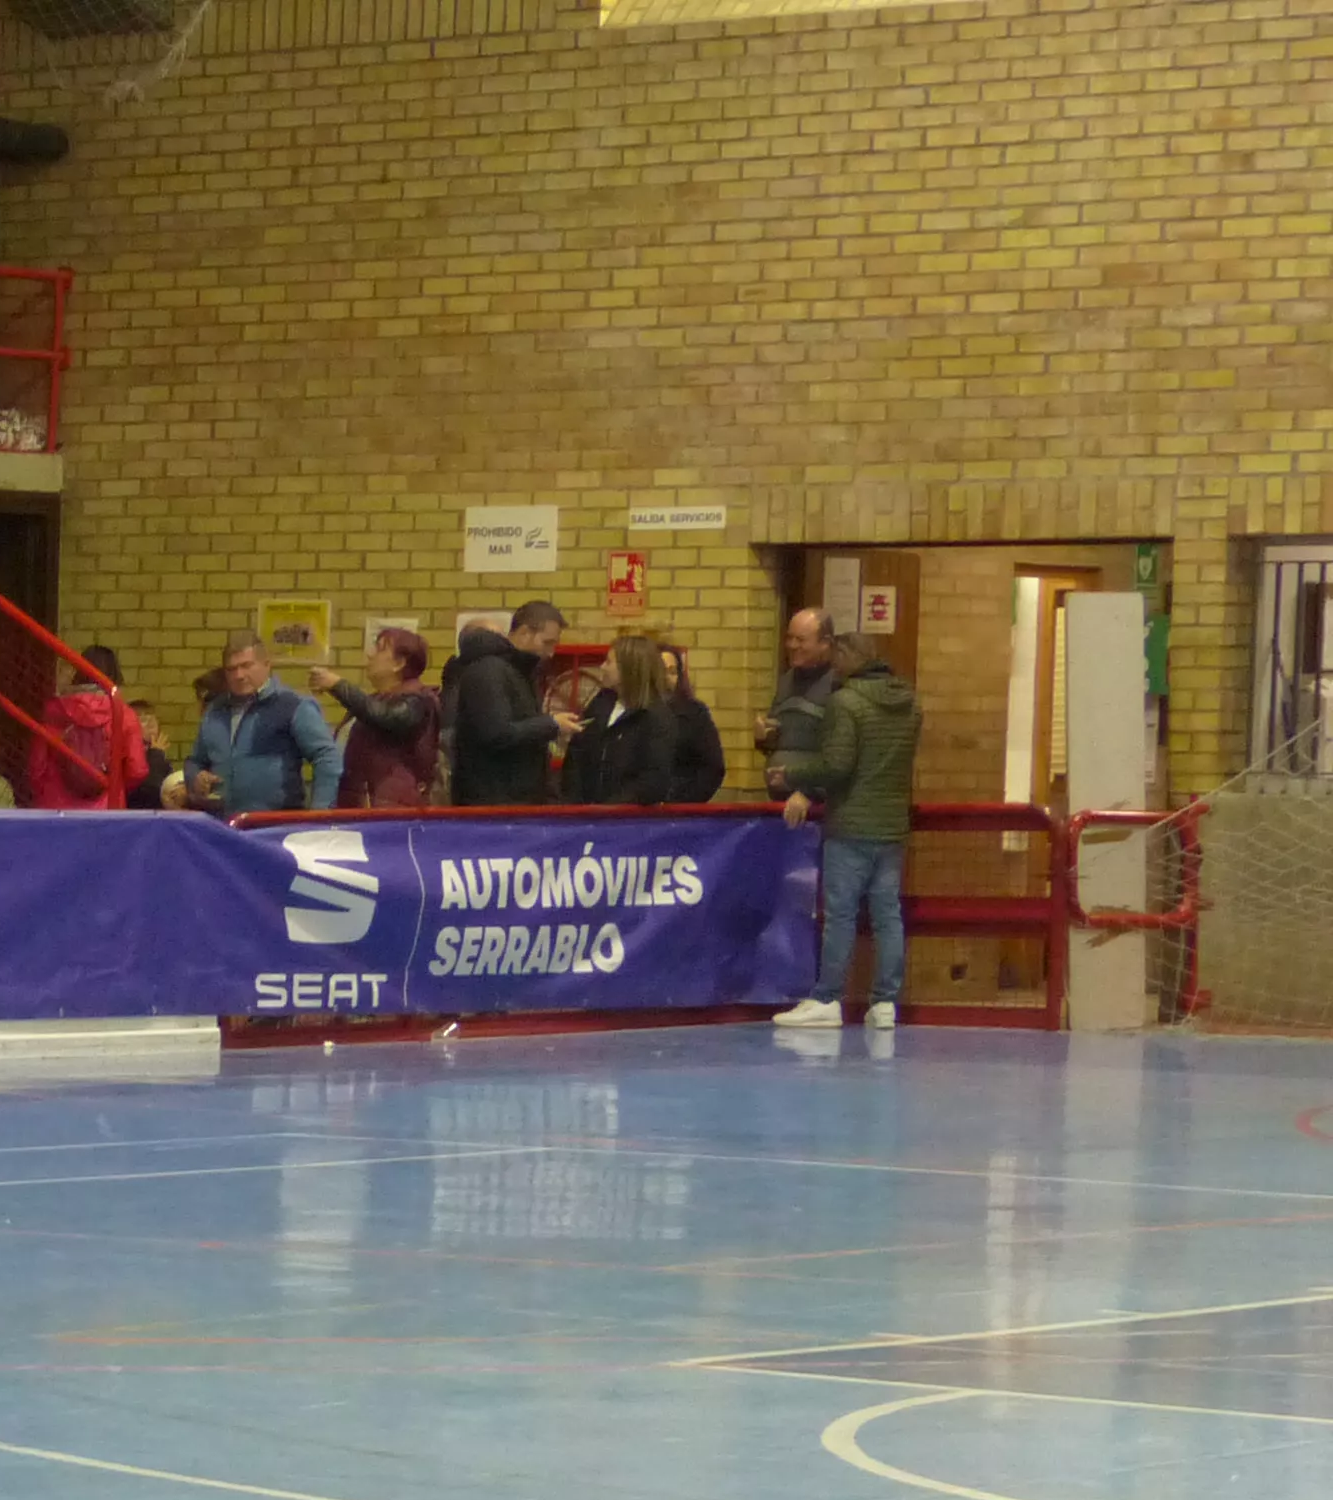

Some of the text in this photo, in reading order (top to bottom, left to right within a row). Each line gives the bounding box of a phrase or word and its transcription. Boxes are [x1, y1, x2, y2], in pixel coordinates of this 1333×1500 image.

[467, 526, 522, 538] PROHIBIDO
[631, 511, 722, 524] SALIDA SERVICIOS
[440, 841, 703, 911] AUTOMÓVILES
[428, 923, 625, 977] SERRABLO
[254, 973, 388, 1009] SEAT
